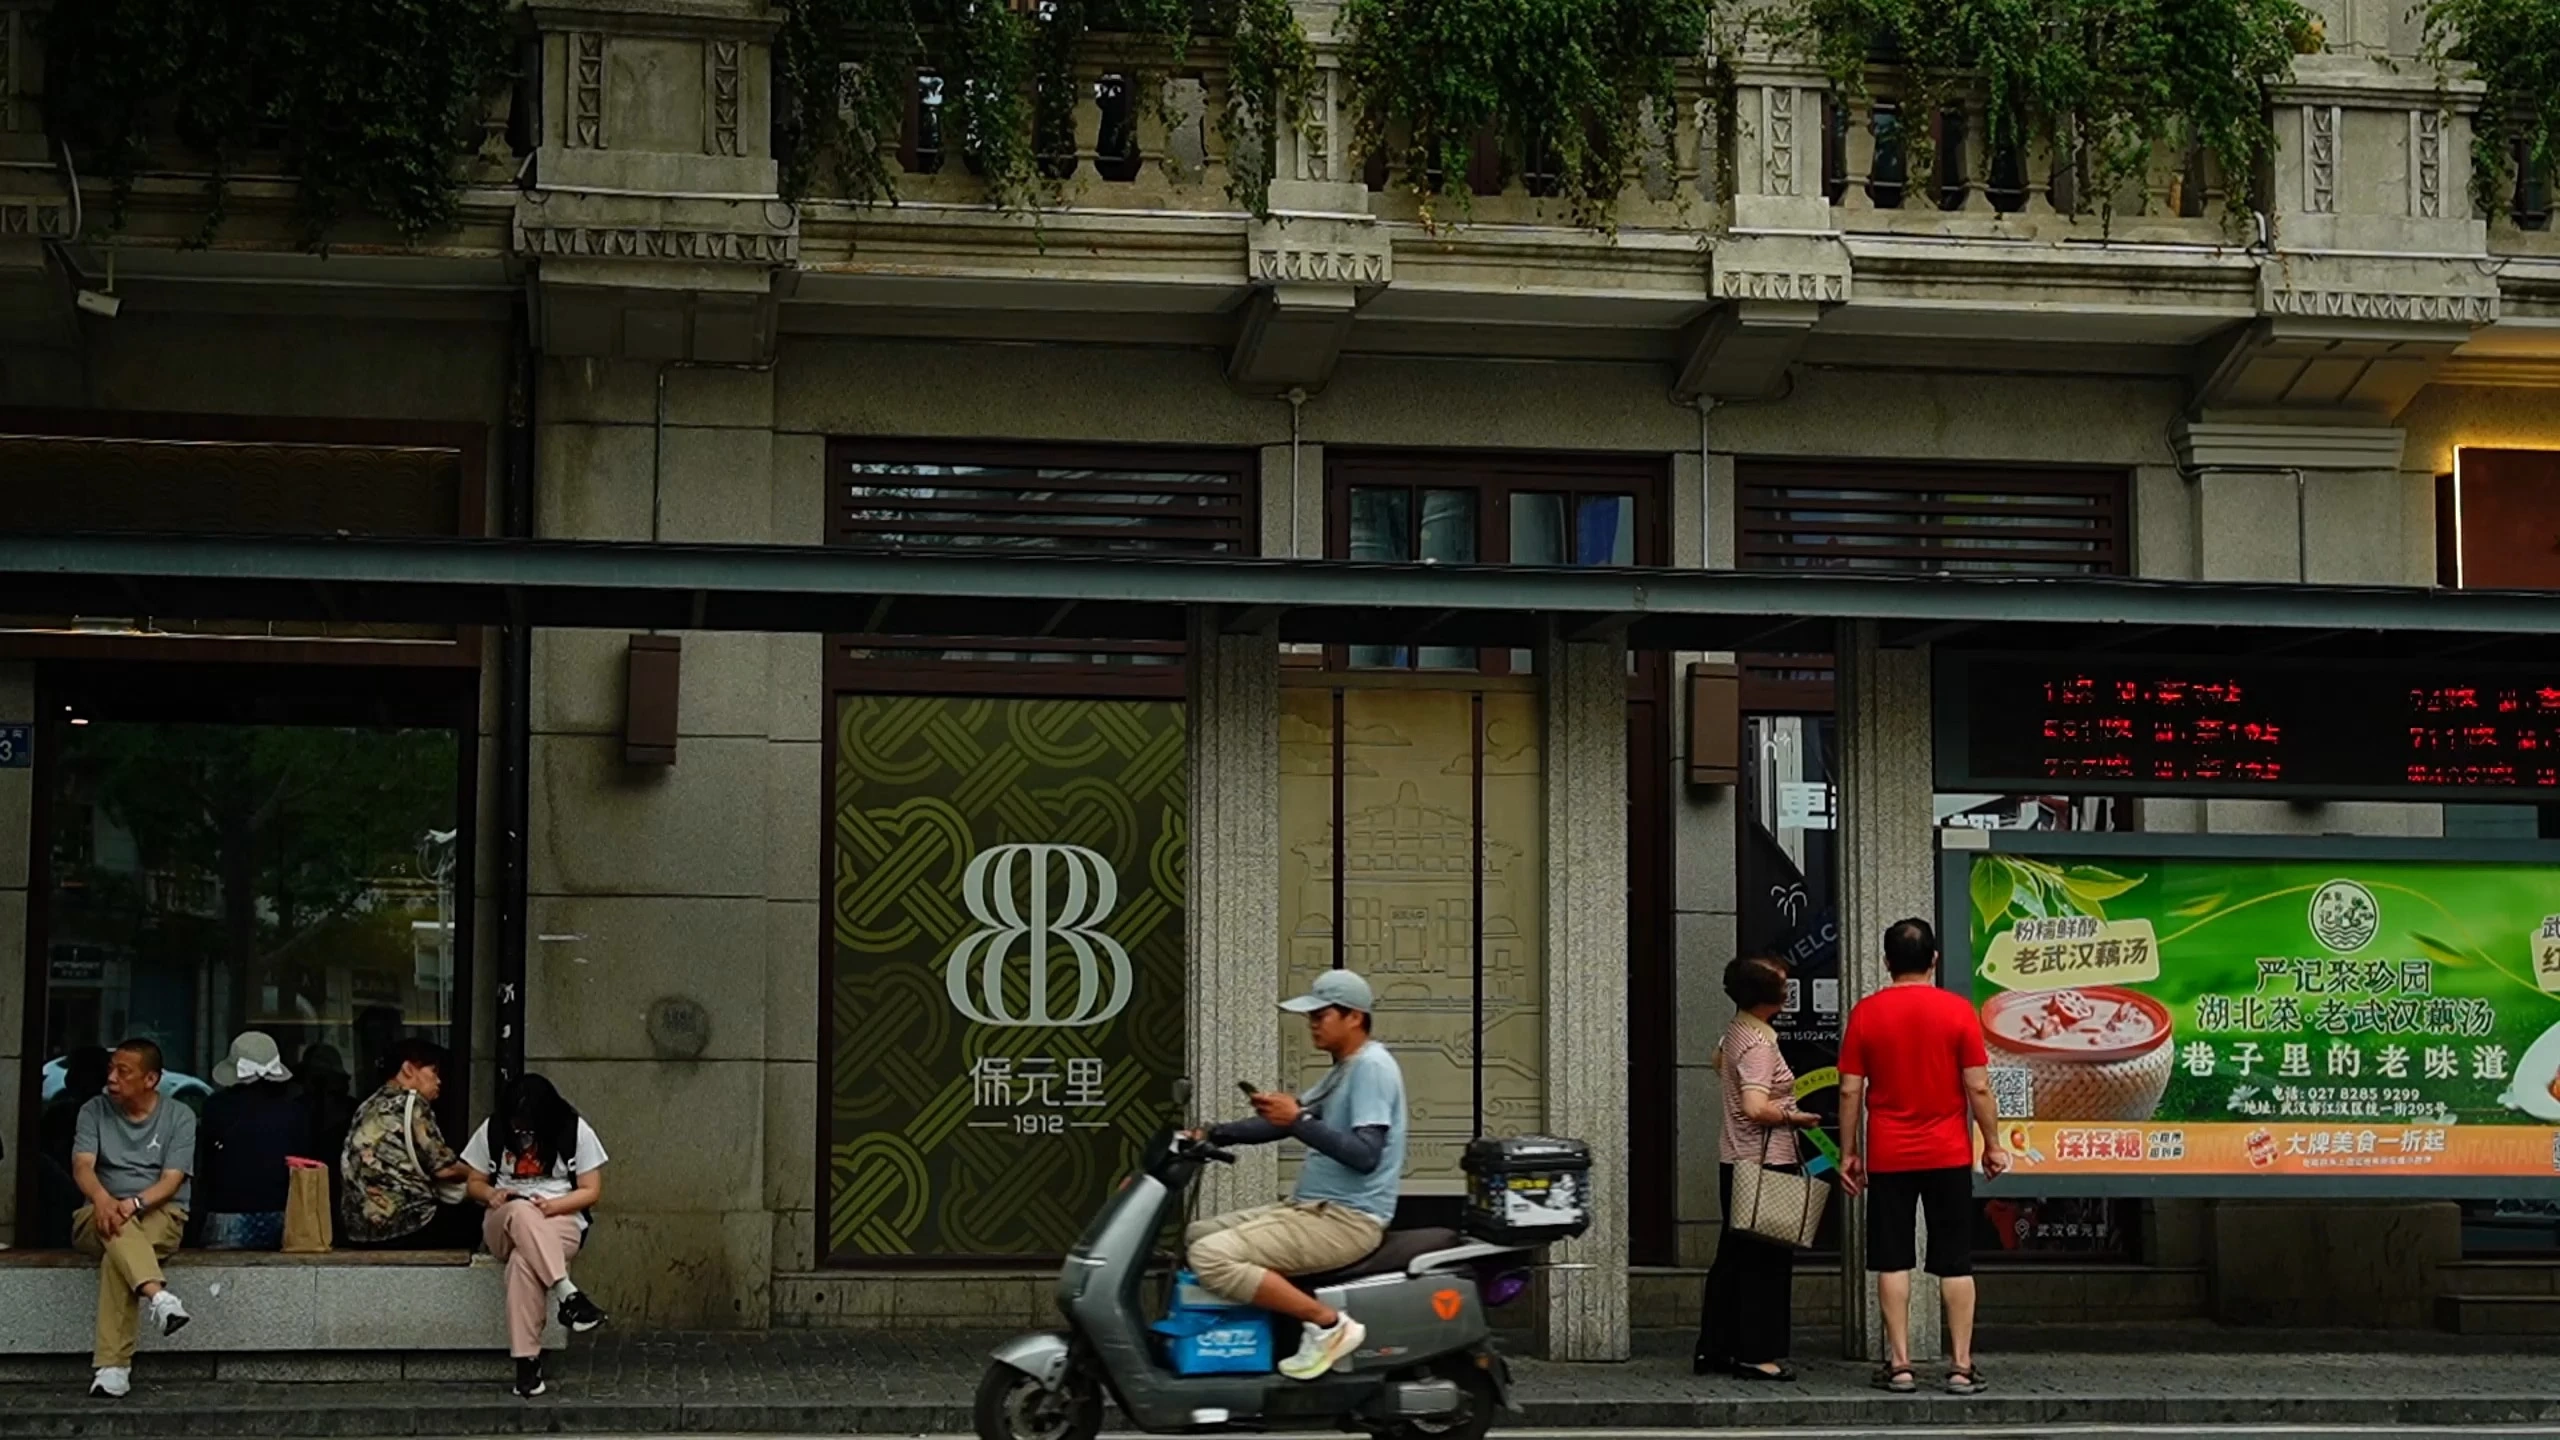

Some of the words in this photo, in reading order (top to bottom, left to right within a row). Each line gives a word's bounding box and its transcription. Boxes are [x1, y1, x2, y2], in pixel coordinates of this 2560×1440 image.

[2013, 937, 2148, 975] 老武汉藕汤
[2256, 959, 2431, 994] 严记聚珍园
[2196, 998, 2495, 1035] 湖北菜·老武汉藕汤
[2182, 1043, 2507, 1079] 巷子里的老味道
[968, 1056, 1107, 1107] 保元里
[2308, 1088, 2335, 1100] 027
[2340, 1088, 2378, 1100] 8285
[2383, 1087, 2420, 1100] 9299
[1013, 1114, 1064, 1134] 1912
[2056, 1130, 2141, 1158] 探探糖
[2284, 1129, 2446, 1155] 大牌美食一折起
[2036, 1223, 2108, 1238] 武汉保元里
